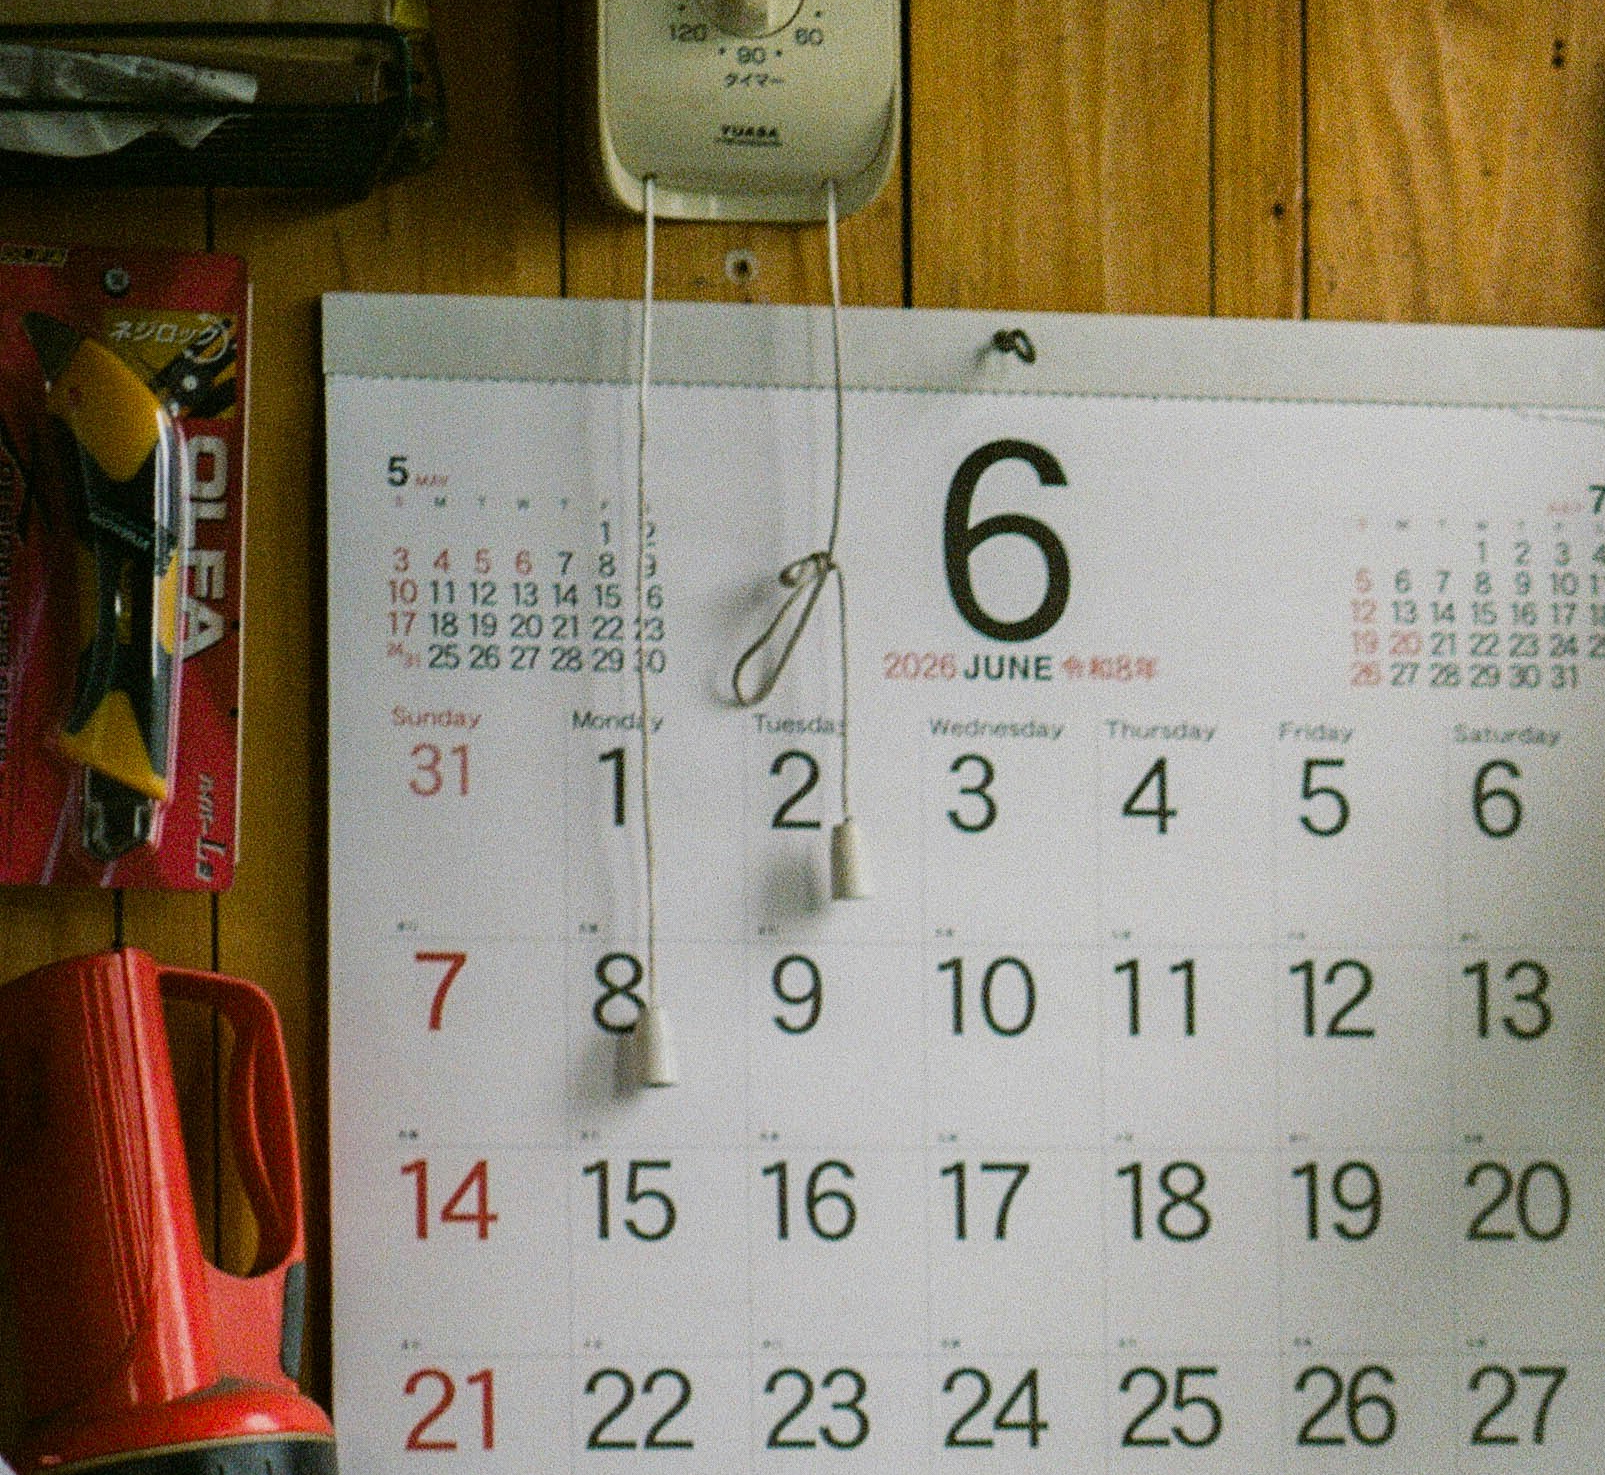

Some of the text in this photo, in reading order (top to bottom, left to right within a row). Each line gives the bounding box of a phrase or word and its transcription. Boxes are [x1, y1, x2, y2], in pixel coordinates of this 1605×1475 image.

[670, 24, 708, 42] 120
[796, 29, 824, 46] 60
[737, 47, 766, 65] 90
[723, 72, 785, 88] タイマー
[720, 125, 780, 138] YUASA
[110, 319, 220, 344] ネジロック
[388, 456, 409, 487] 5
[183, 434, 229, 659] OLFA
[601, 521, 610, 545] 1
[943, 439, 1070, 643] 6
[394, 547, 409, 572] 3
[433, 549, 450, 571] 4
[475, 548, 491, 574] 5
[515, 551, 533, 575] 6
[558, 551, 574, 575] 7
[598, 553, 616, 577] 8
[1478, 540, 1487, 563] 1
[1515, 541, 1530, 566] 2
[1555, 542, 1571, 567] 3
[388, 579, 418, 604] 10
[430, 580, 454, 604] 11
[469, 581, 496, 606] 12
[513, 582, 539, 607] 13
[553, 583, 578, 606] 14
[594, 584, 622, 609] 15
[1395, 569, 1411, 593] 6
[1438, 570, 1450, 592] 7
[1475, 572, 1491, 595] 8
[1515, 572, 1531, 595] 9
[1551, 572, 1579, 596] 10
[389, 611, 417, 635] 17
[430, 612, 458, 637] 18
[469, 612, 498, 637] 19
[510, 613, 543, 638] 20
[552, 615, 579, 639] 21
[591, 615, 624, 640] 22
[1392, 600, 1418, 625] 13
[1431, 602, 1455, 623] 14
[1471, 601, 1498, 626] 15
[1511, 603, 1537, 626] 16
[1551, 603, 1577, 625] 17
[429, 644, 460, 669] 25
[470, 644, 500, 669] 26
[511, 645, 541, 670] 27
[551, 646, 584, 672] 28
[591, 648, 624, 672] 29
[1391, 632, 1422, 655] 20
[1431, 632, 1456, 656] 21
[1470, 632, 1499, 657] 22
[1510, 633, 1539, 657] 23
[1550, 635, 1578, 657] 24
[884, 652, 1158, 682] 2026 JUNE 令和8年
[1391, 662, 1420, 686] 27
[1431, 663, 1460, 687] 28
[1471, 665, 1501, 687] 29
[1511, 665, 1540, 689] 30
[1552, 665, 1578, 690] 31
[392, 705, 481, 732] Sunday
[755, 713, 846, 734] Tuesda
[929, 718, 1065, 743] Wednesday
[1106, 719, 1218, 745] Thursday
[1279, 721, 1354, 746] Friday
[1453, 724, 1561, 748] Saturday
[409, 743, 1523, 839] 31 1 2 3 4 5 6
[415, 952, 1553, 1041] 7 8 9 10 11 12 13
[401, 1159, 1571, 1242] 14 15 16 17 18 19 20
[404, 1365, 1567, 1451] 21 22 23 24 25 26 27
